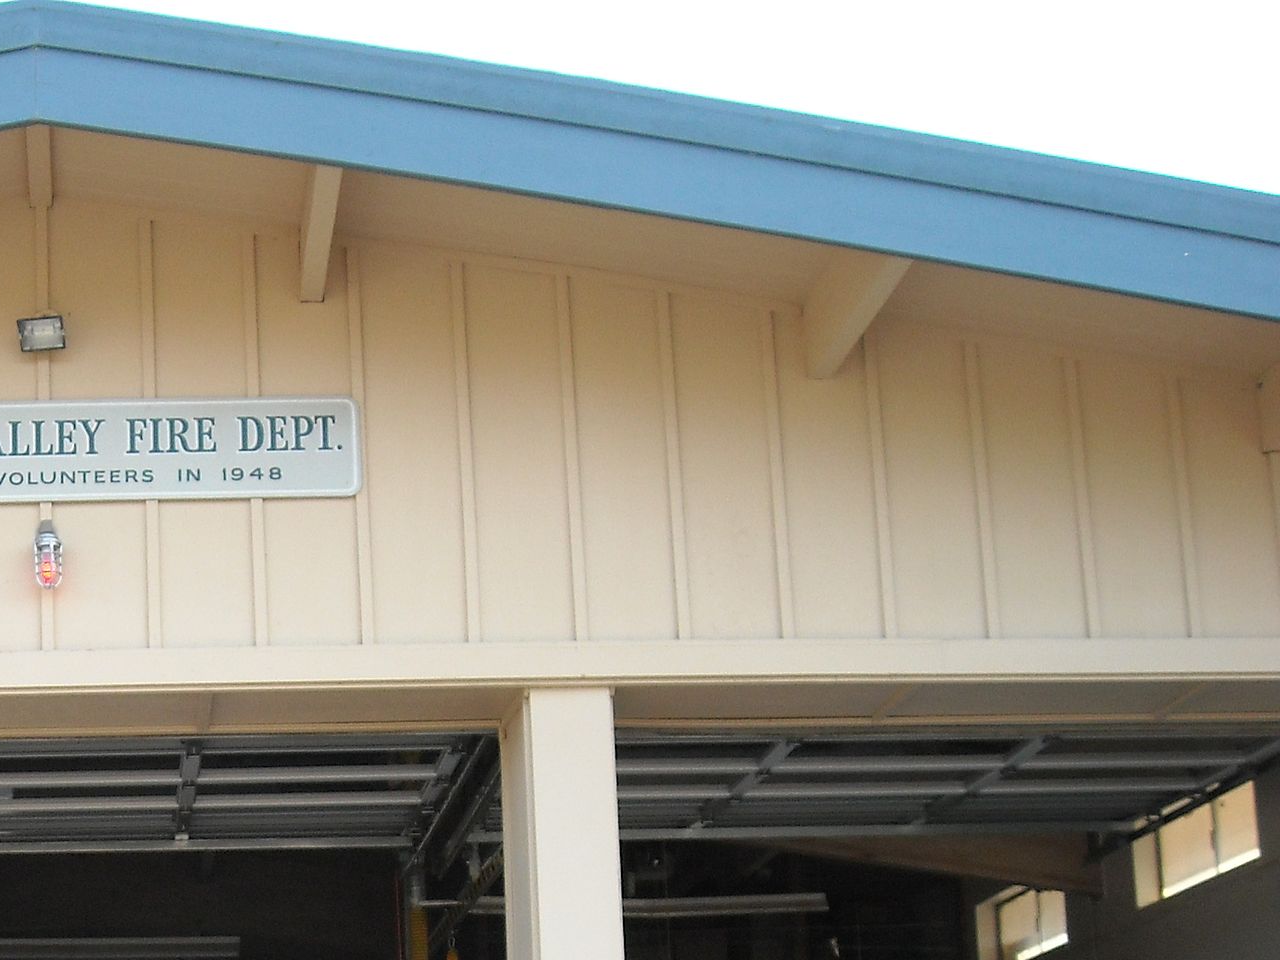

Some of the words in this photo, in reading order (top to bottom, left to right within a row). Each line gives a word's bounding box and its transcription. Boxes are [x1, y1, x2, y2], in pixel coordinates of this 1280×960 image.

[125, 416, 217, 454] FIRE
[237, 414, 344, 453] DEPT.
[178, 468, 201, 482] IN
[221, 466, 283, 481] 1948
